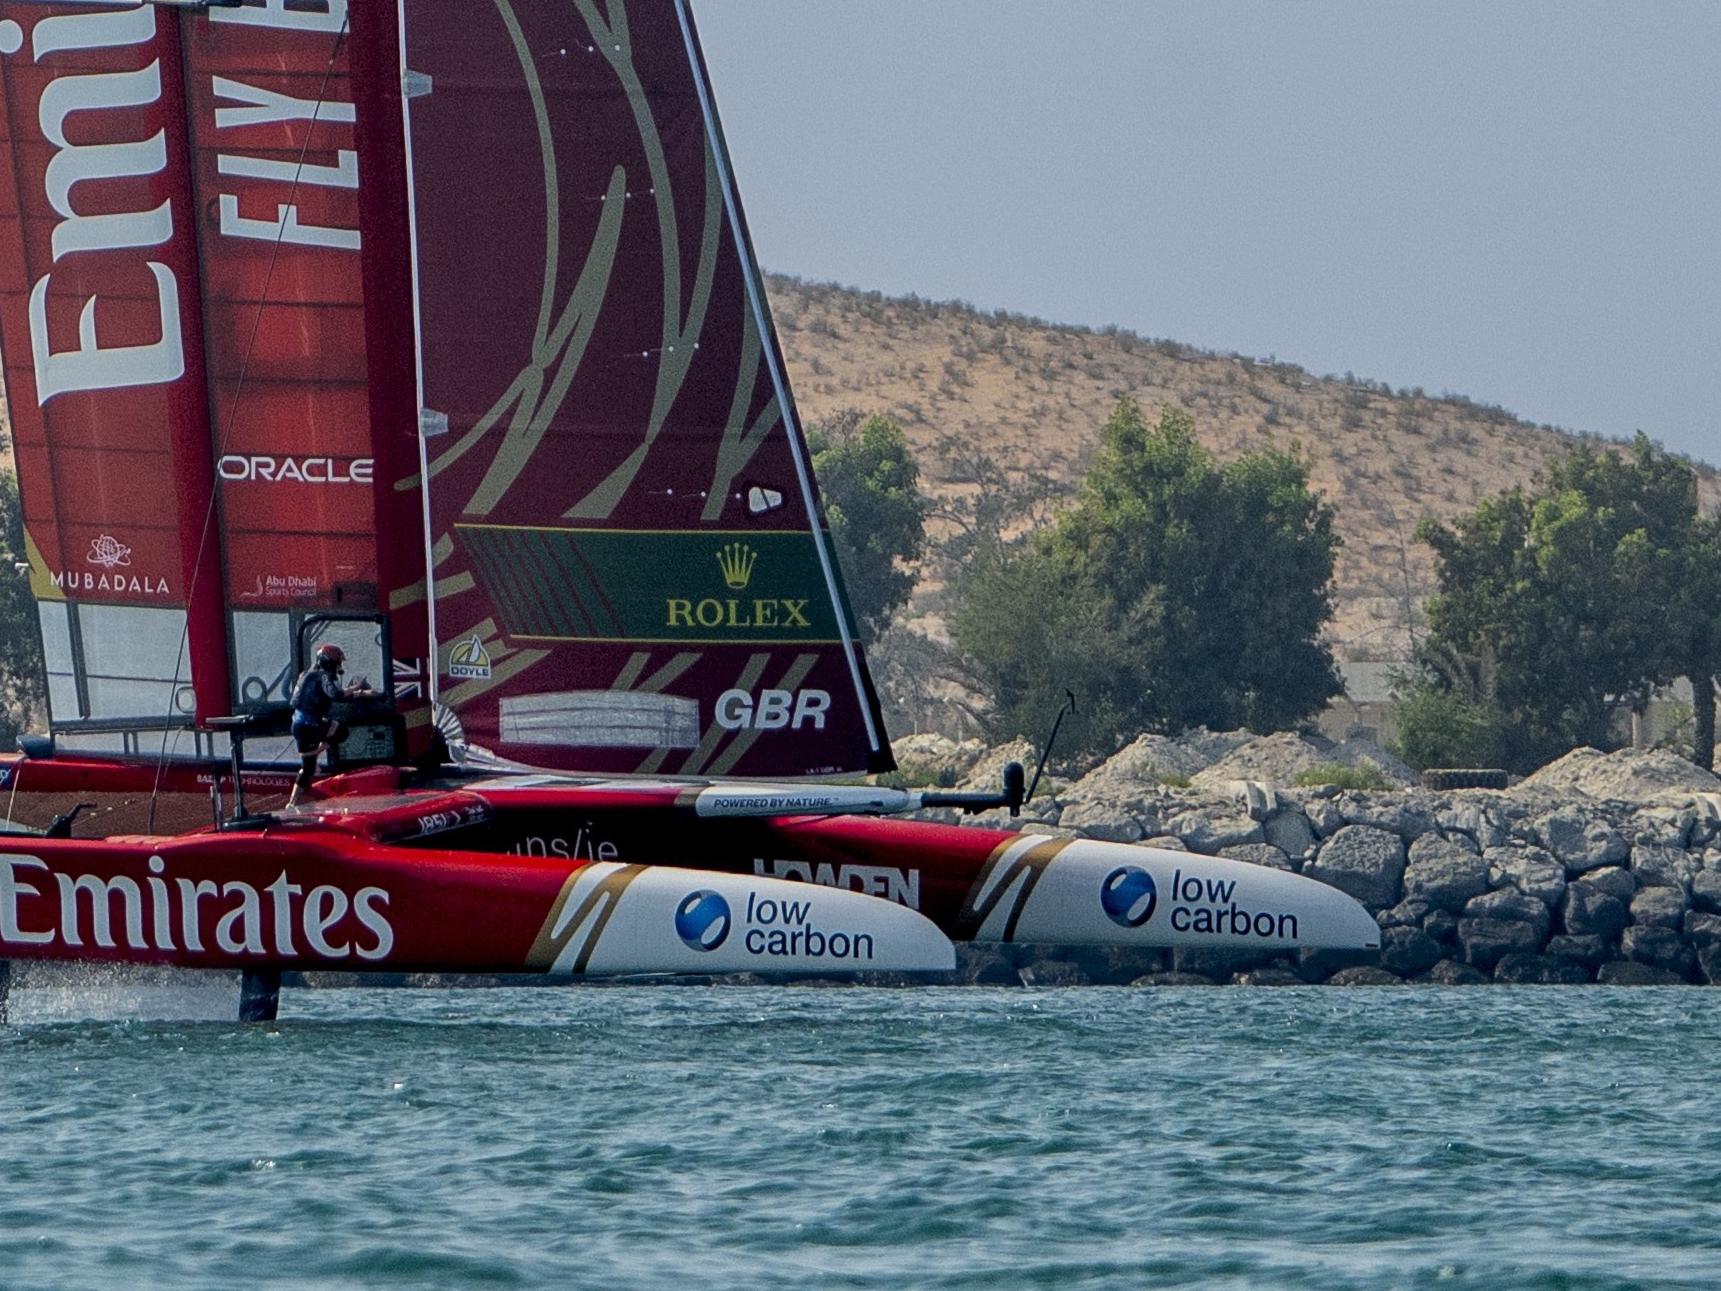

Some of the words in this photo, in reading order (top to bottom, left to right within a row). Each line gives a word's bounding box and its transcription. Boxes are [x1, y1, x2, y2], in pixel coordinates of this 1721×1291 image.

[214, 77, 361, 250] FLY
[218, 455, 375, 483] ORACLE
[50, 571, 170, 594] MUBADALA
[265, 576, 285, 587] Abu
[287, 576, 317, 587] Dhabi
[265, 587, 291, 597] Sports
[293, 586, 317, 597] Council
[666, 599, 811, 627] ROLEX
[450, 665, 490, 677] DOYLE
[714, 688, 831, 730] GBR
[714, 798, 768, 808] POWERED
[769, 798, 785, 807] BY
[1172, 869, 1236, 902] low
[747, 892, 811, 925] low
[1171, 902, 1298, 939] carbon
[745, 922, 874, 961] carbon
